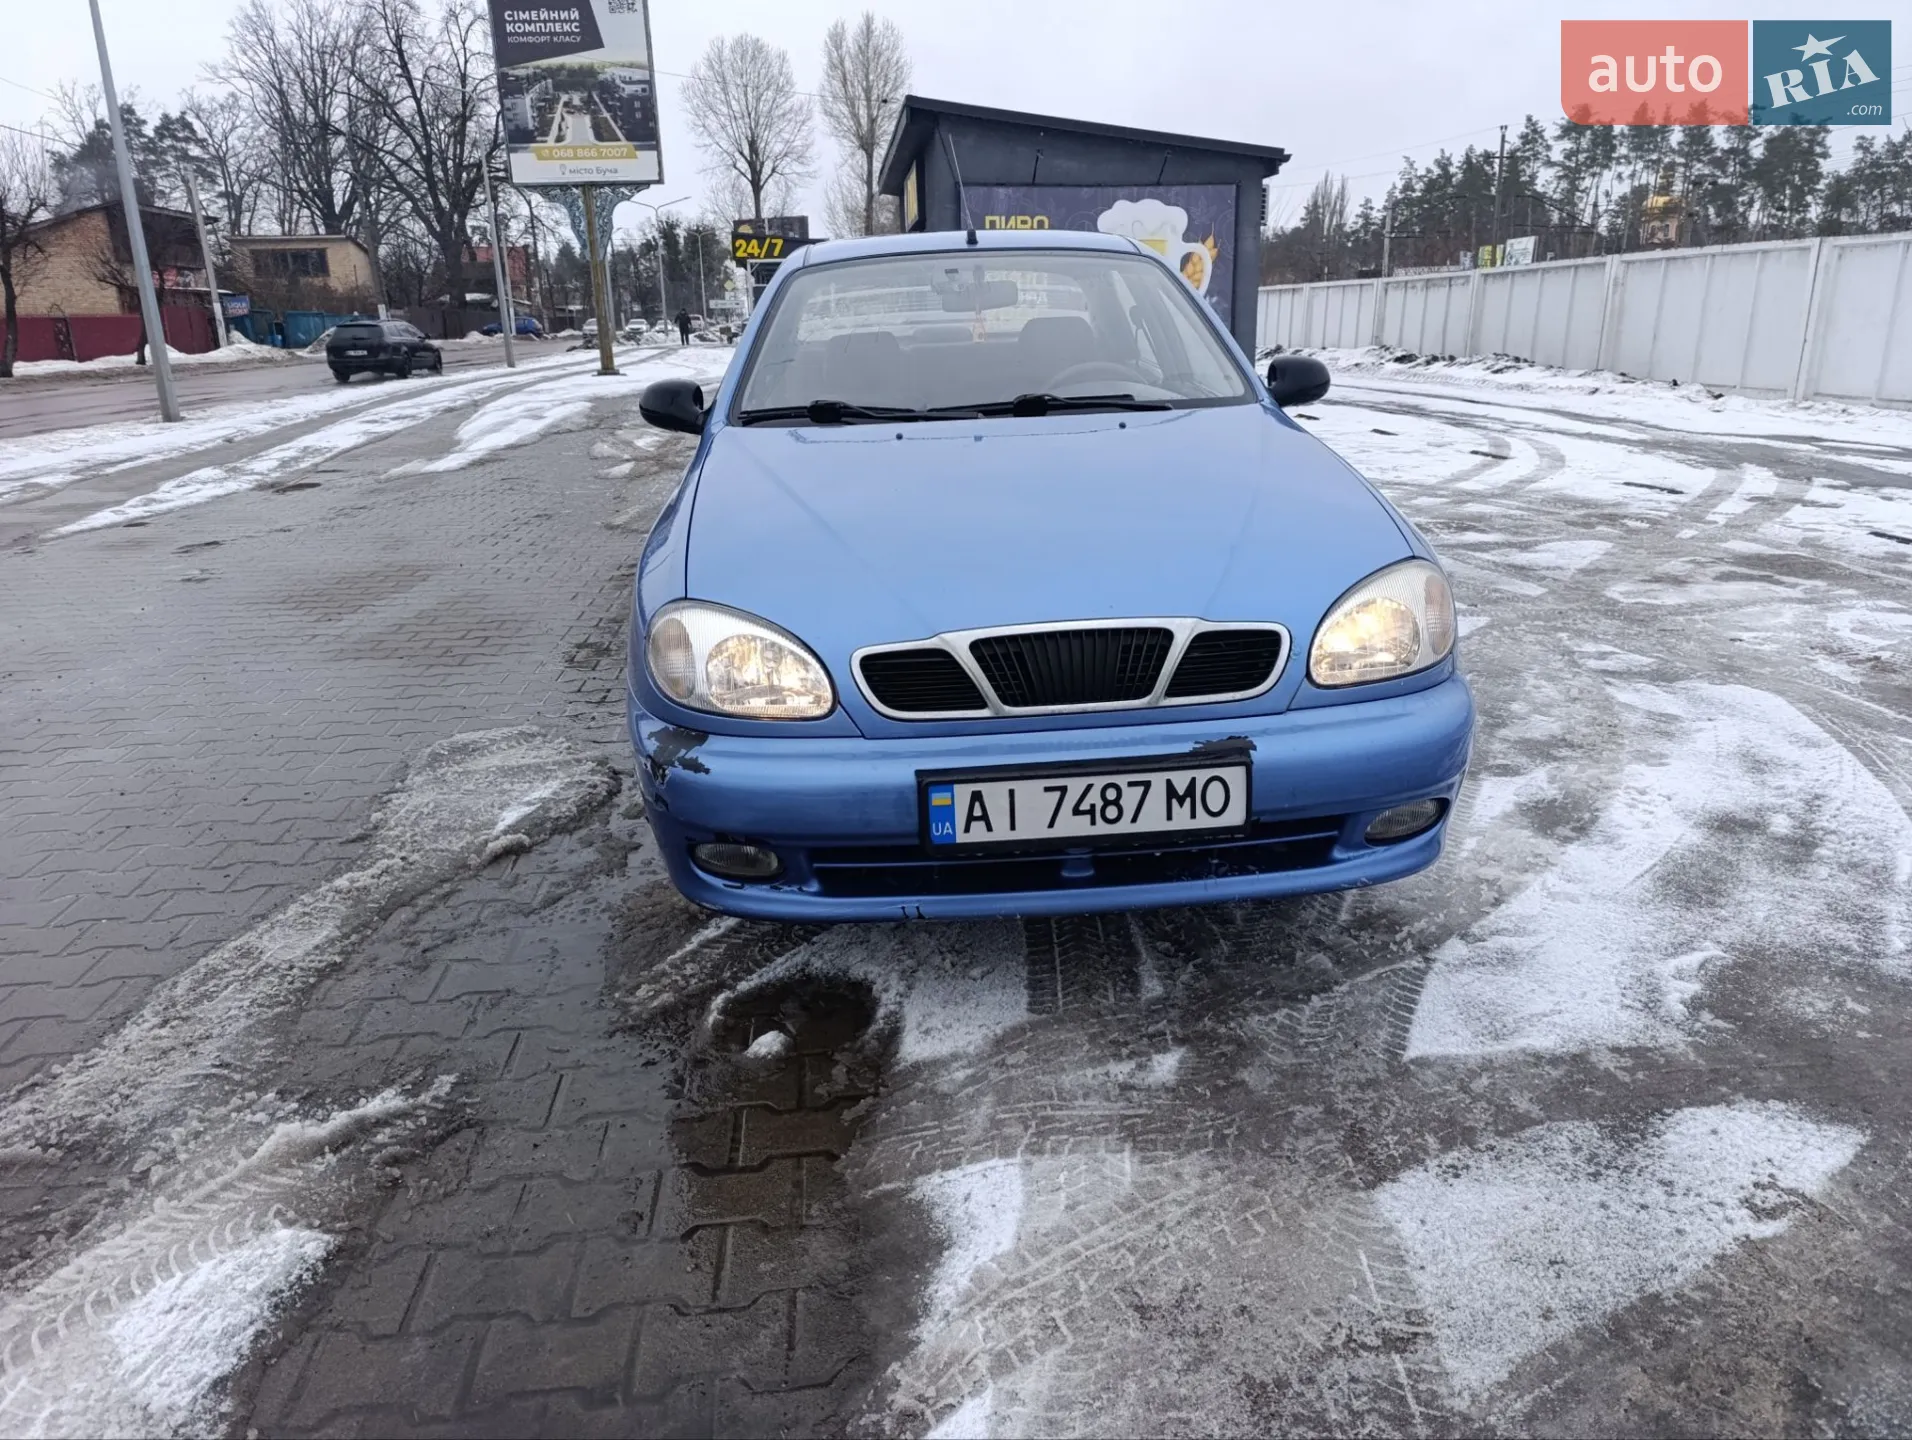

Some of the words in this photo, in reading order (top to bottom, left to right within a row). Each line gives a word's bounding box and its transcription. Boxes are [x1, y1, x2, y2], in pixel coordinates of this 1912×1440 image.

[504, 8, 580, 21] СІМЕЙНИЙ
[506, 22, 580, 33] КОМПЛЕКС
[553, 35, 582, 43] КЛАСУ
[553, 147, 573, 158] 068
[577, 147, 597, 158] 866
[600, 147, 628, 158] 7007
[569, 166, 593, 175] місто
[595, 166, 618, 176] Буча
[735, 237, 784, 259] 24/7
[963, 788, 1016, 834] AI
[1043, 780, 1152, 829] 7487
[1165, 774, 1231, 821] MO
[932, 822, 953, 836] UA
